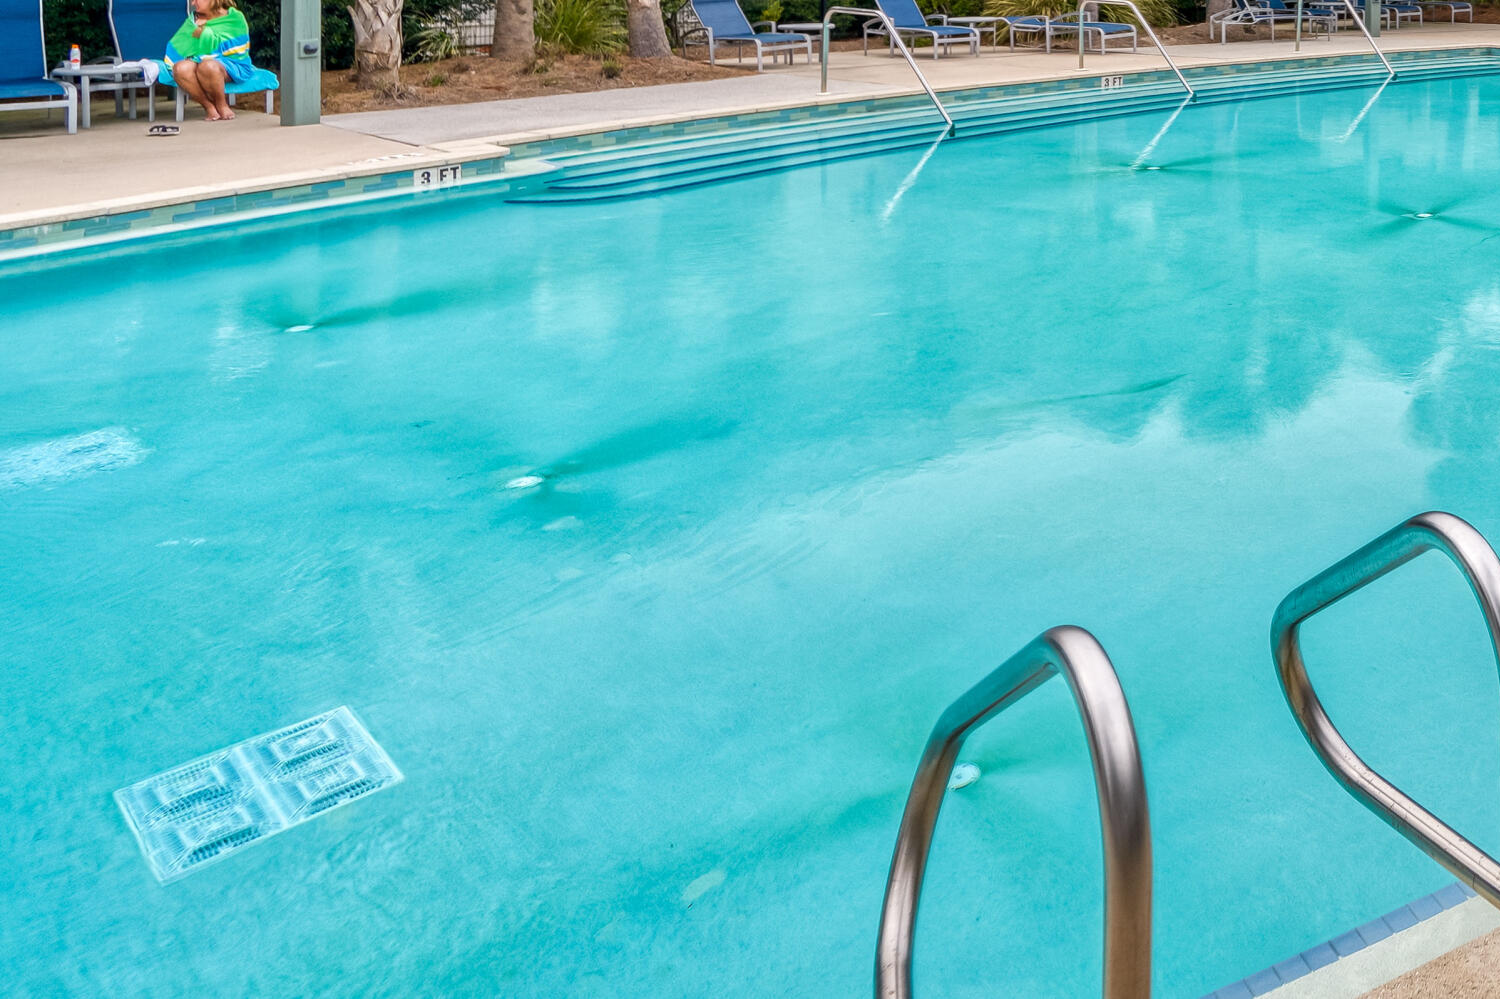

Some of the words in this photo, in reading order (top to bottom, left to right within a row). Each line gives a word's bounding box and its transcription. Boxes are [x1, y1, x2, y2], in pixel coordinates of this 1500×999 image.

[1104, 77, 1110, 87] 3
[1112, 76, 1122, 86] FT
[420, 171, 431, 184] 3
[439, 165, 460, 182] FT
